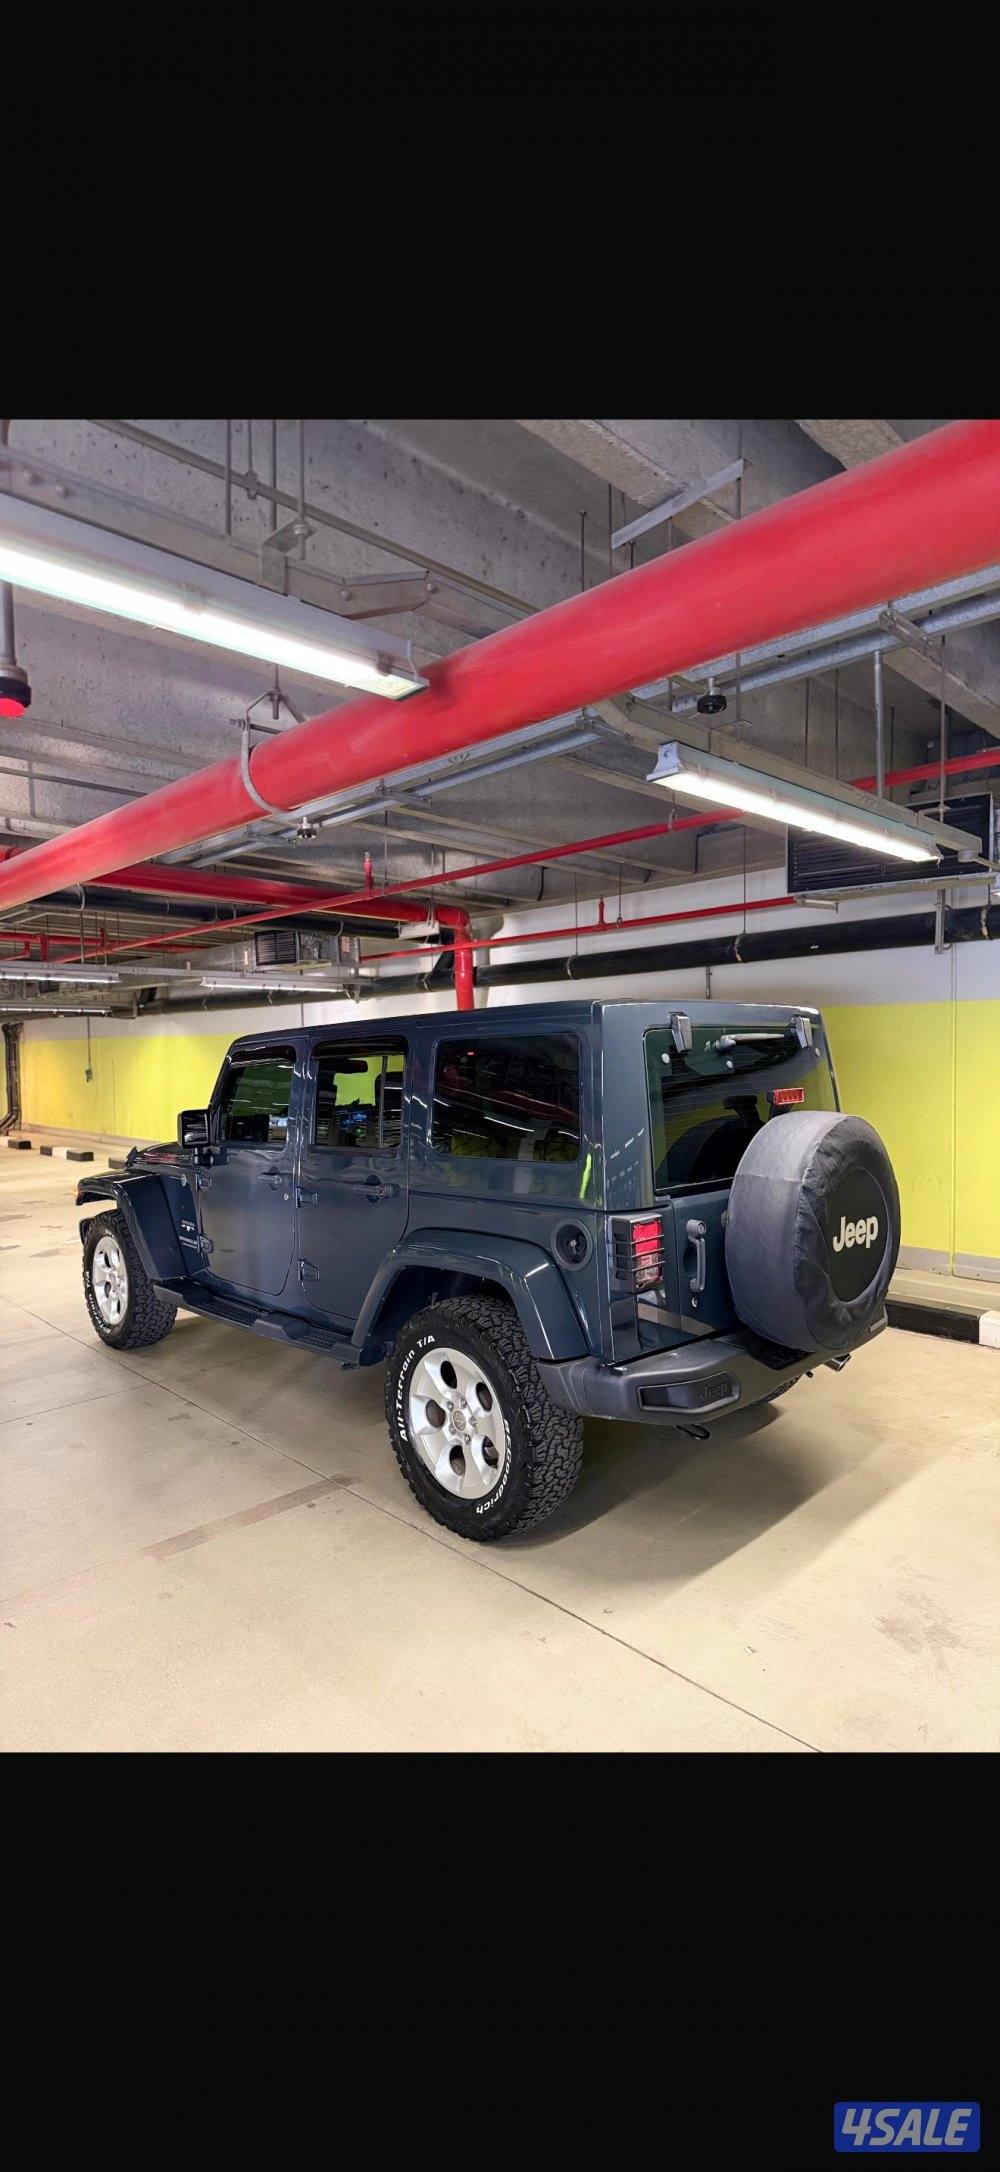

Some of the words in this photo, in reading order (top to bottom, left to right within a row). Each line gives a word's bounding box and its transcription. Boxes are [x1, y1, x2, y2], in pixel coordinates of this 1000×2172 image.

[832, 1215, 879, 1253] Jeep
[395, 1349, 416, 1442] All-Terrain
[416, 1334, 436, 1349] T/A
[700, 1380, 729, 1401] Jeep
